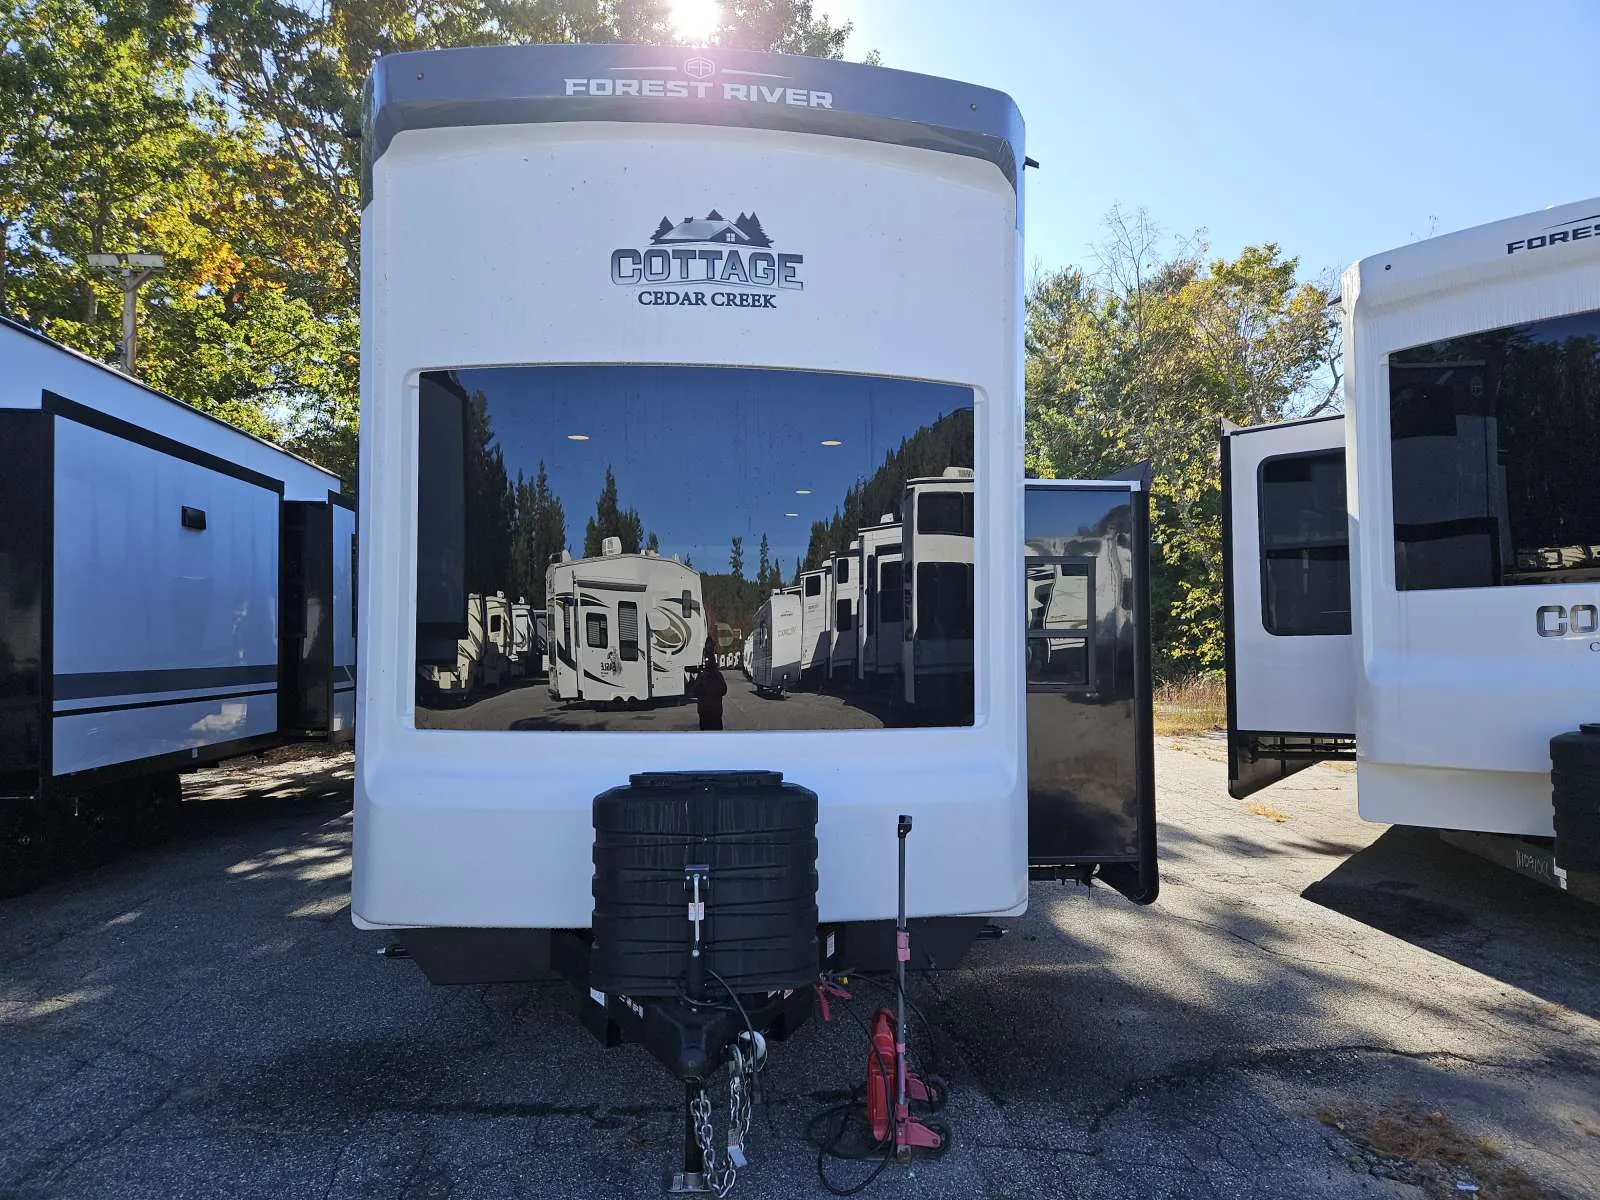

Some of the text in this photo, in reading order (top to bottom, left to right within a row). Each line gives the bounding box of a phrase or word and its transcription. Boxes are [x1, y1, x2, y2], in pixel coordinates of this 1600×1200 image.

[564, 78, 833, 109] FOREST RIVER
[611, 248, 804, 291] COTTAGE
[638, 291, 777, 309] CEDAR CREEK
